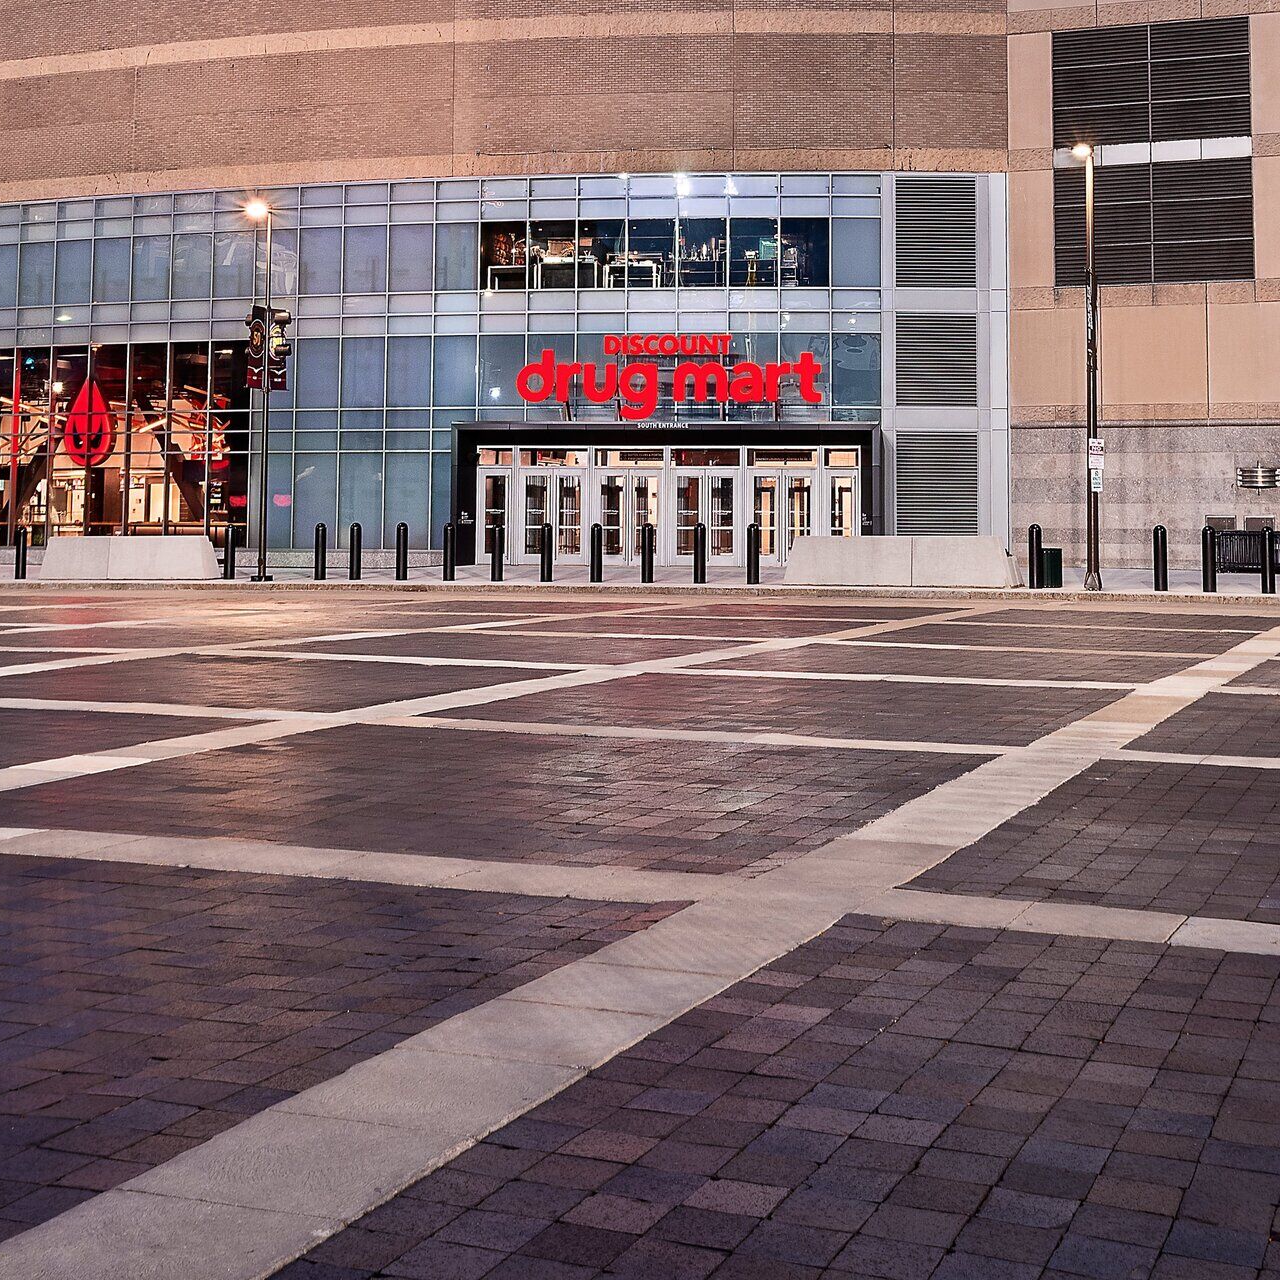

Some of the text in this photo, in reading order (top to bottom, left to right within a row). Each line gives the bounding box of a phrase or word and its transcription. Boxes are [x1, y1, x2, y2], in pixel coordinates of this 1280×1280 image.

[604, 334, 733, 356] DISCOUNT
[516, 348, 823, 421] drug mart
